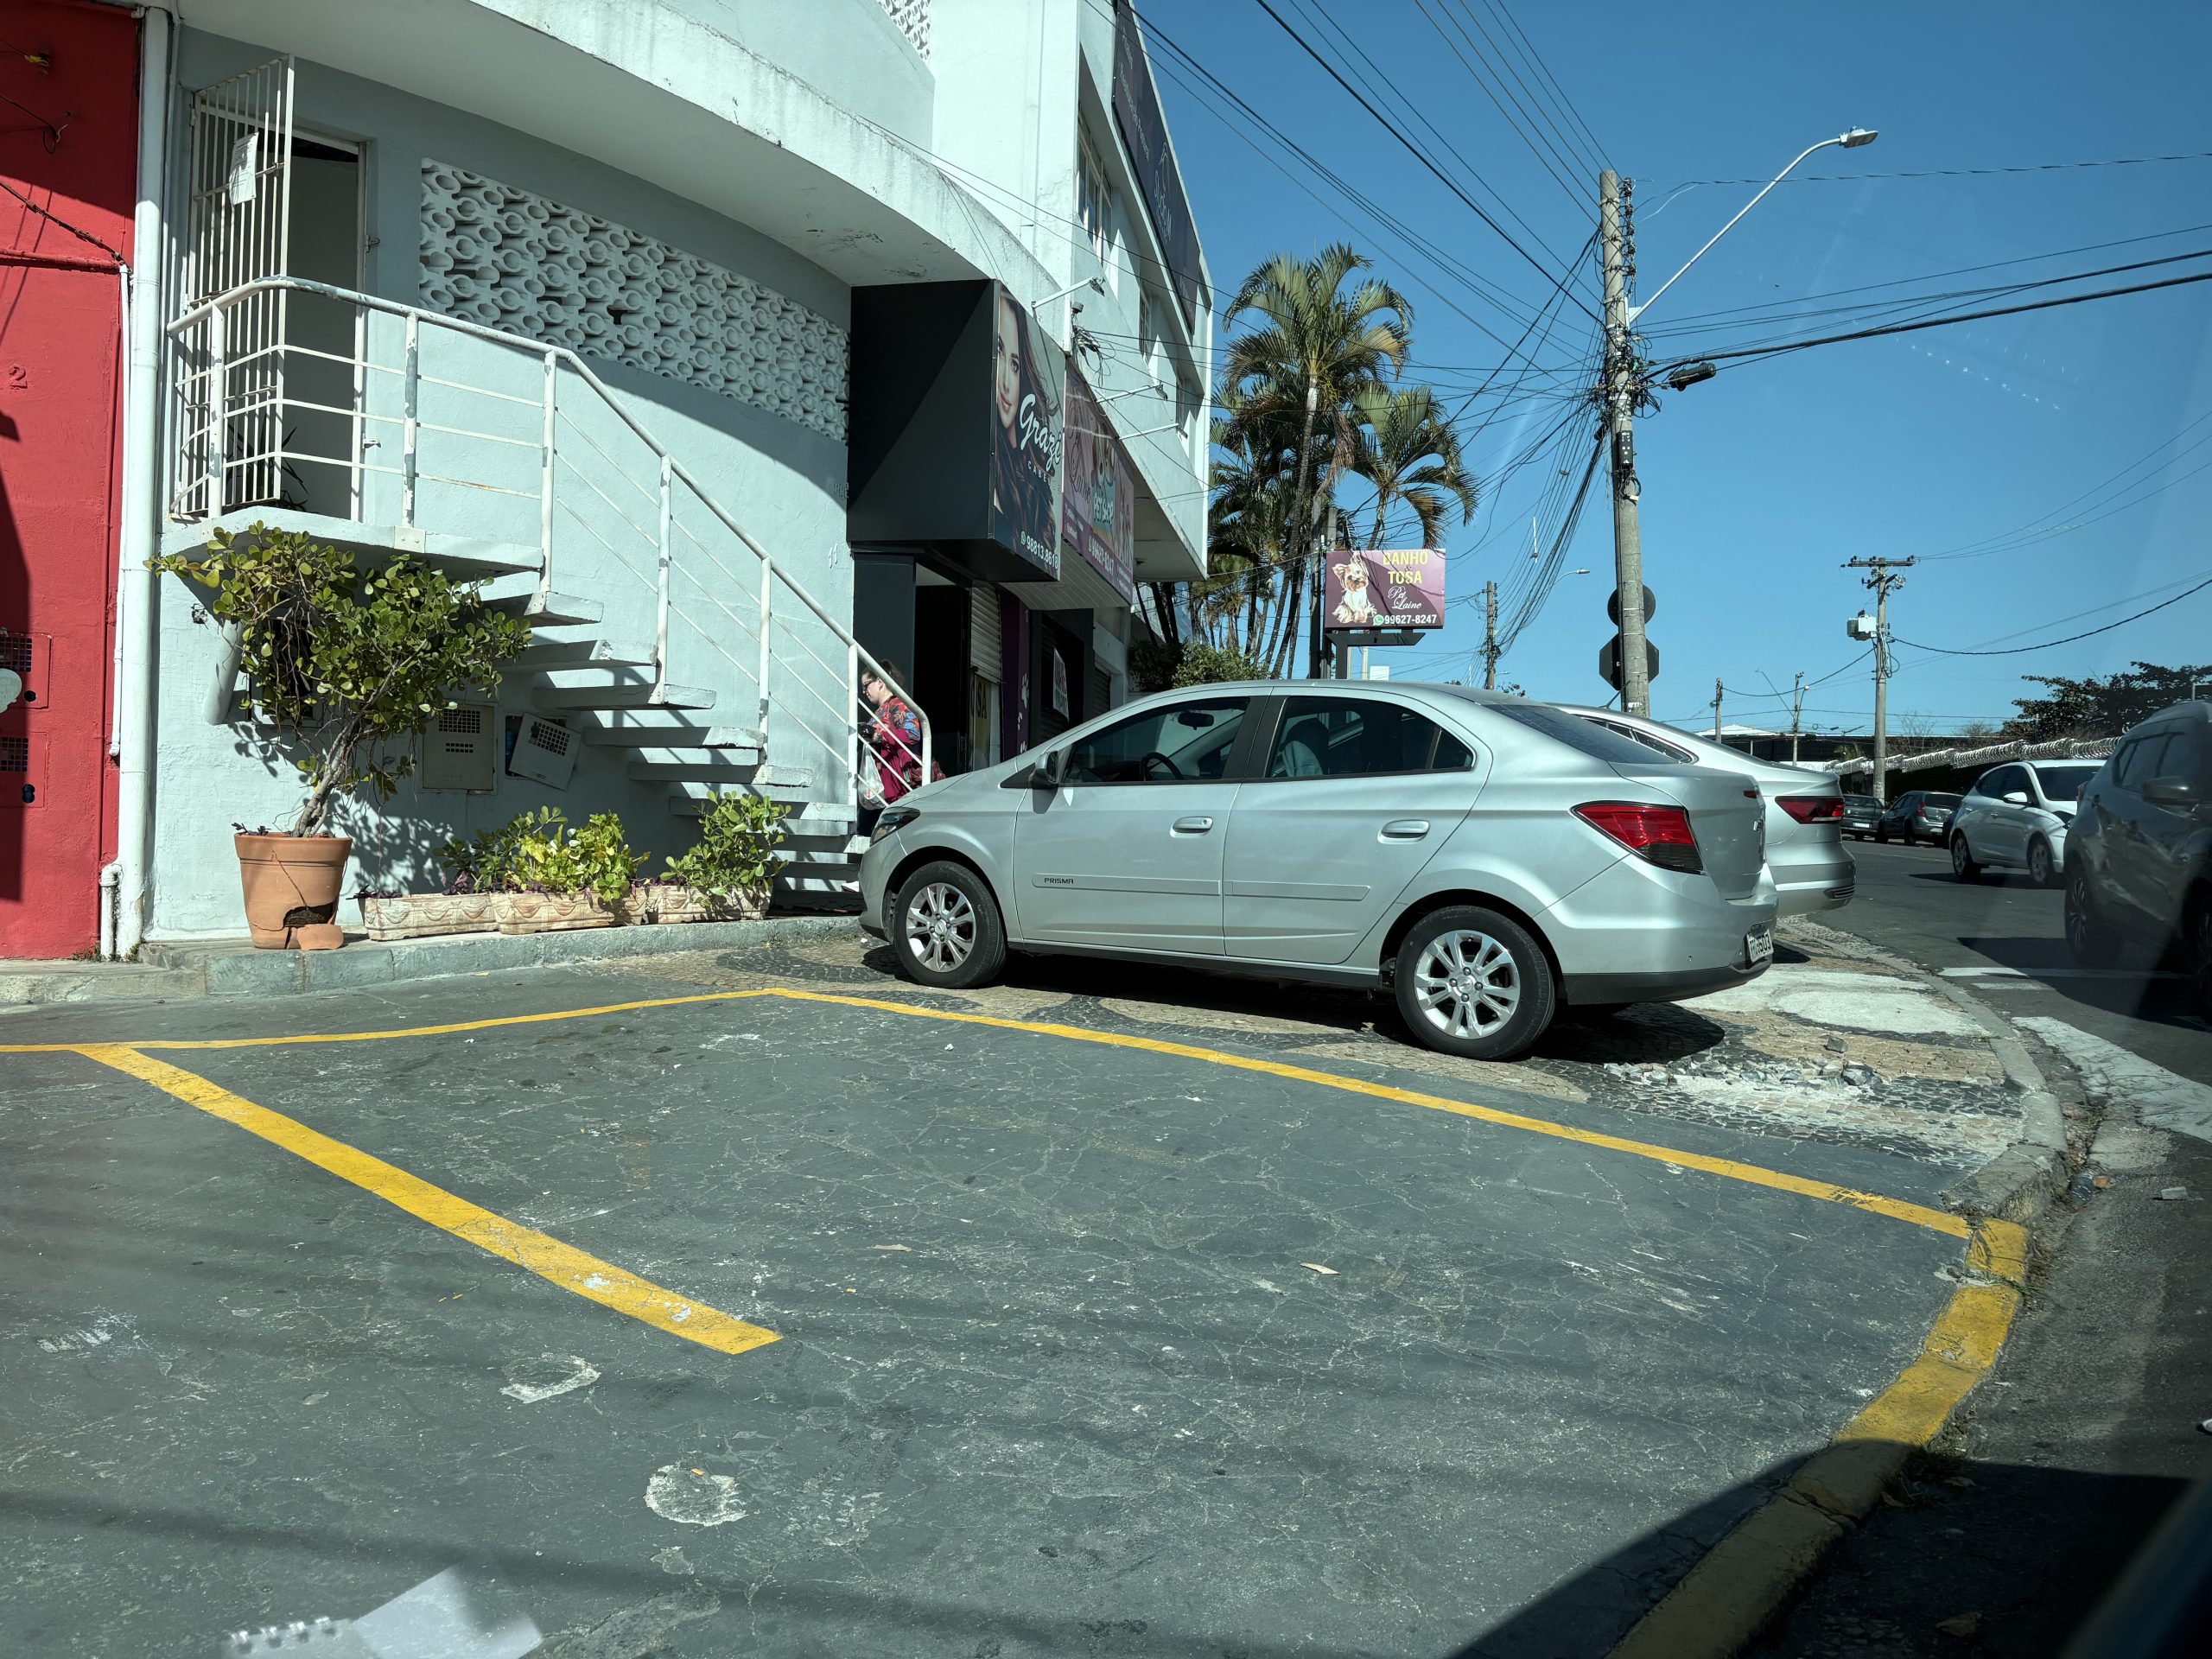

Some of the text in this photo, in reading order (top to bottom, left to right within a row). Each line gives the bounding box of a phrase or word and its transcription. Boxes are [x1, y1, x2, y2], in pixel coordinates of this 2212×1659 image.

[9, 363, 28, 390] 2
[1020, 393, 1062, 471] Grazi
[1093, 493, 1103, 523] PET
[1103, 498, 1114, 524] SHOP
[1027, 534, 1059, 570] 98813.8618
[1382, 550, 1428, 566] BANHO
[1388, 570, 1423, 584] TOSA
[1388, 585, 1407, 599] Pet
[1392, 596, 1422, 610] Laine
[1384, 614, 1437, 624] 99627-8247
